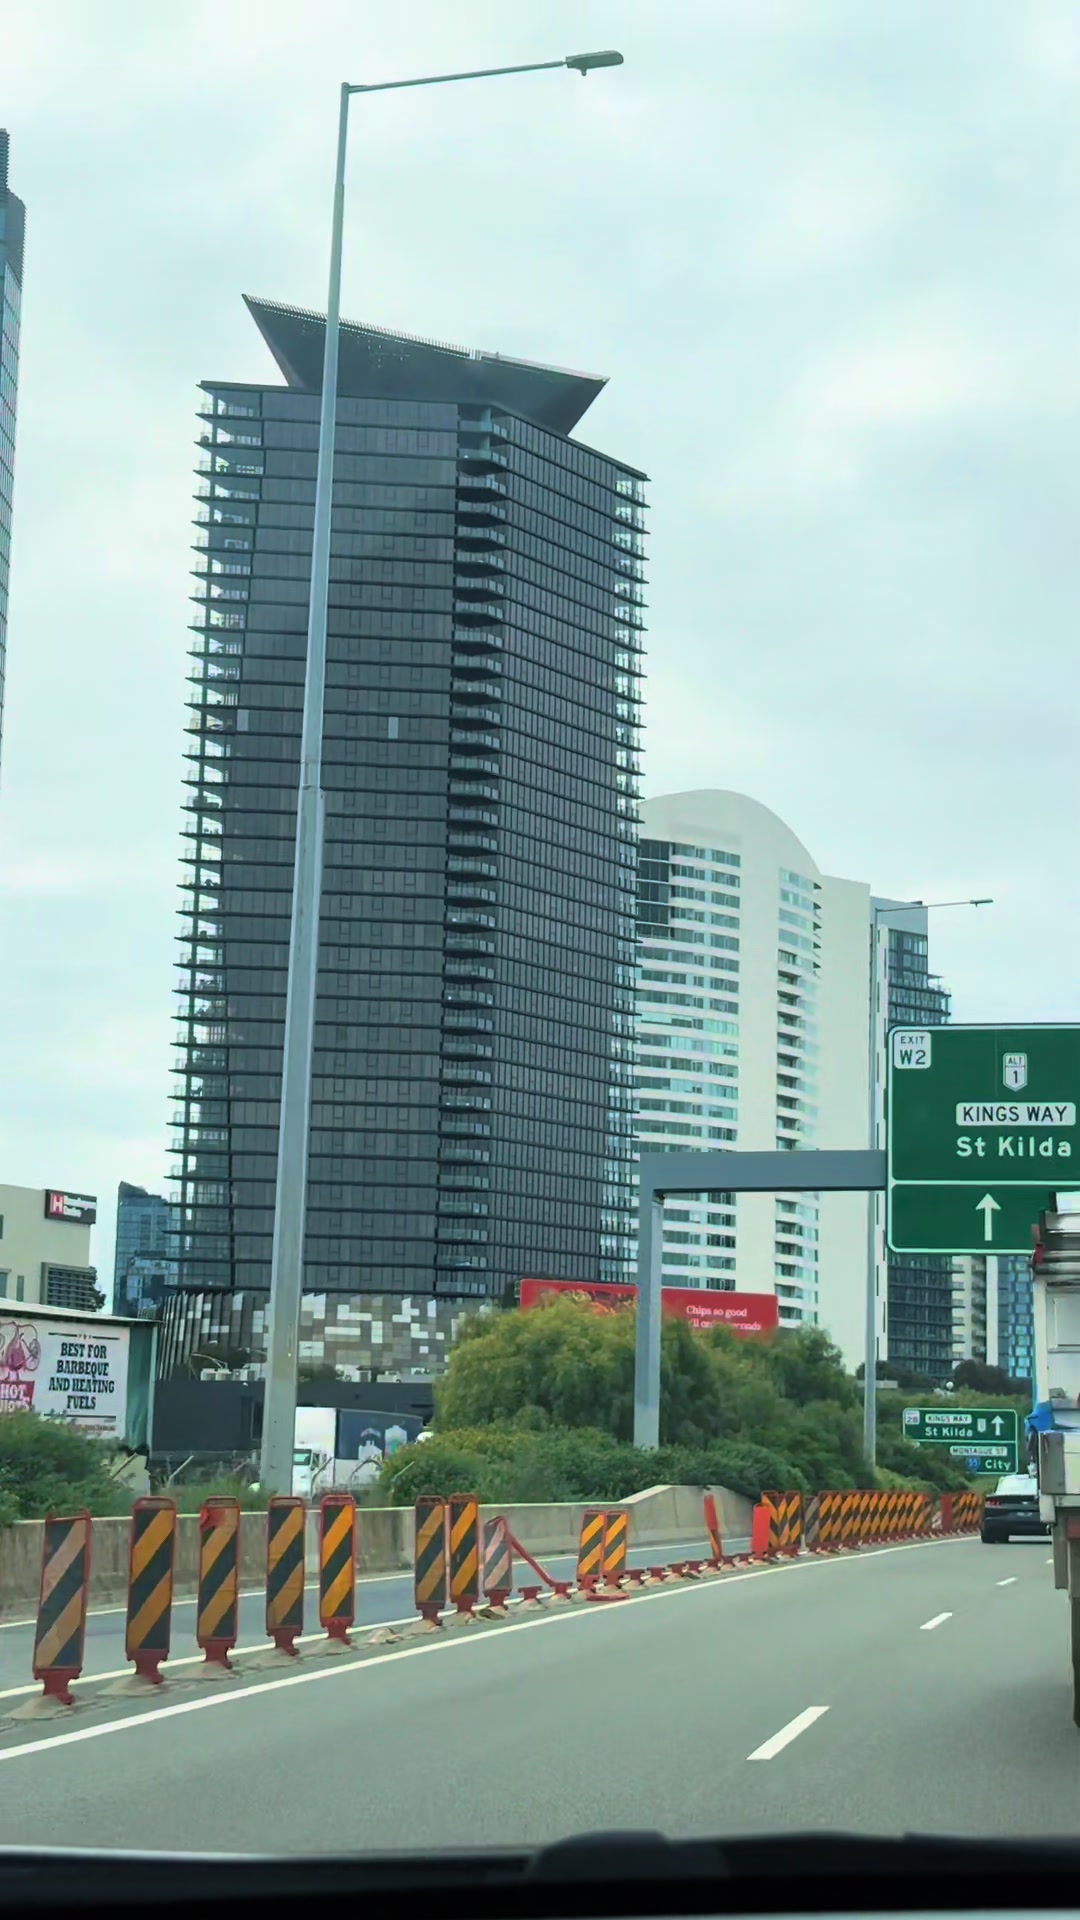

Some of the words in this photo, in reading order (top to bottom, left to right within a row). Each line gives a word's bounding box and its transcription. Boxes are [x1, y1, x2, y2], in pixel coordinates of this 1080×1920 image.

[900, 1035, 925, 1045] EXIT
[900, 1050, 926, 1065] W2
[1008, 1057, 1022, 1065] ALT
[1013, 1070, 1018, 1084] 1
[963, 1106, 1020, 1122] KINGS
[1027, 1106, 1068, 1122] WAY
[956, 1136, 986, 1157] St
[998, 1136, 1071, 1157] Kilda
[686, 1305, 711, 1317] Chips
[725, 1308, 748, 1319] good
[60, 1342, 86, 1357] BEST
[87, 1344, 107, 1359] FOR
[56, 1360, 109, 1378] BARBEQUE
[48, 1377, 70, 1392] AND
[71, 1378, 115, 1394] HEATING
[66, 1395, 96, 1410] FUELS
[925, 1427, 938, 1436] St
[942, 1427, 973, 1437] Kilda
[985, 1459, 1011, 1470] City
